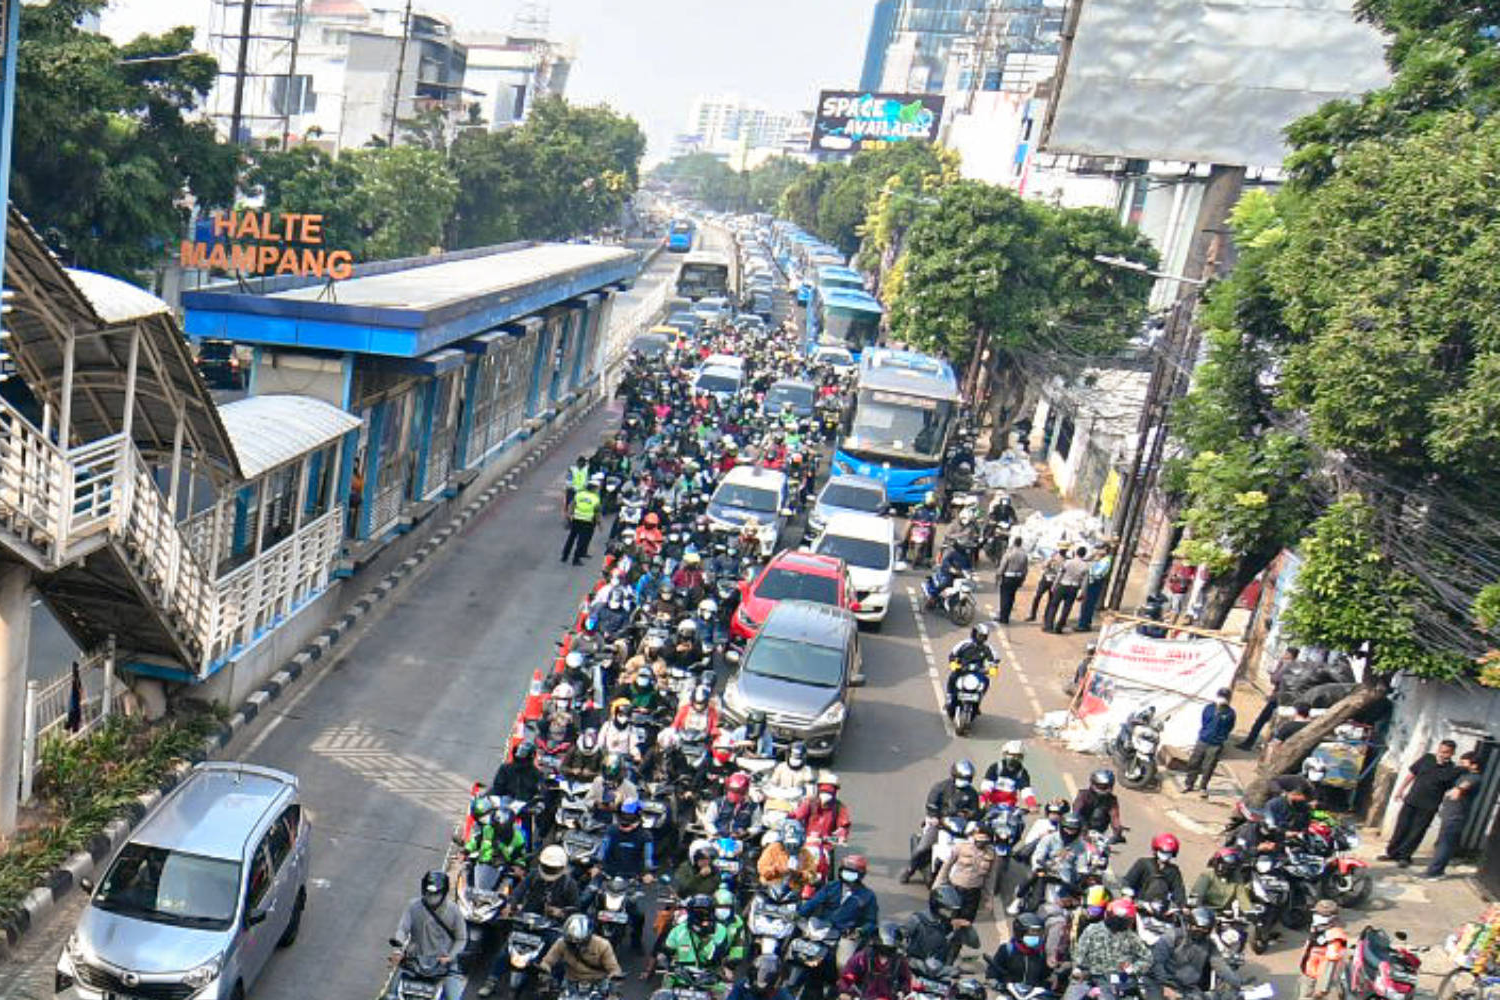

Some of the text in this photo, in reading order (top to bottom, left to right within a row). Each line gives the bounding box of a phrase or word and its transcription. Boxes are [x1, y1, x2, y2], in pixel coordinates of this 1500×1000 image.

[822, 97, 885, 118] SPACE
[214, 210, 323, 244] HALTE
[180, 240, 353, 280] MAMPANG
